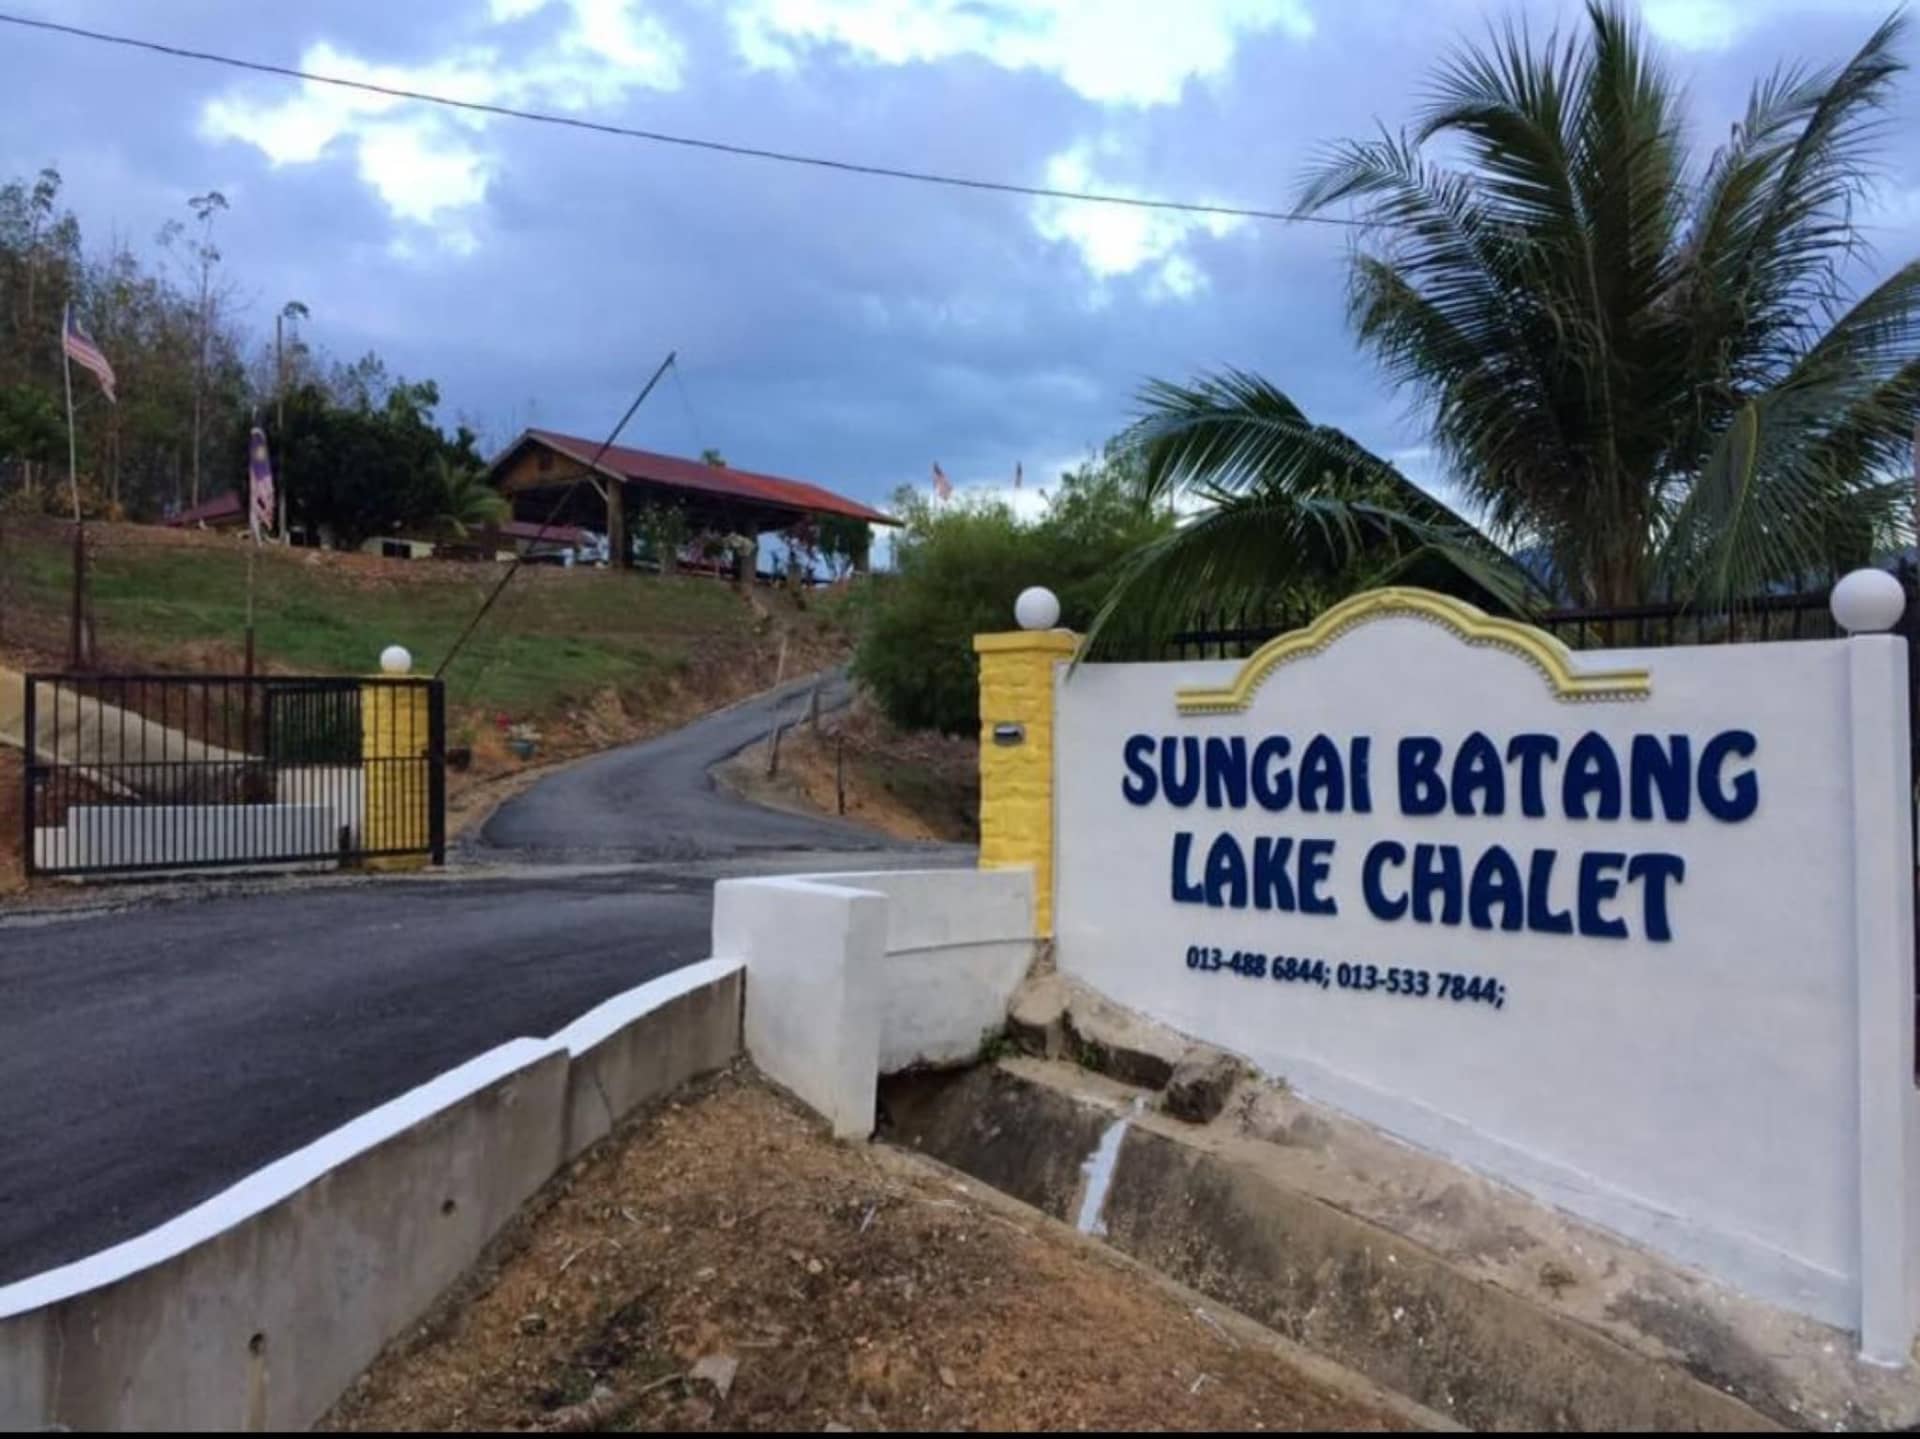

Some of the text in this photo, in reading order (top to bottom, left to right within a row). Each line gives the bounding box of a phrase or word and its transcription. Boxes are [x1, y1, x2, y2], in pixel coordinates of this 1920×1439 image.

[1121, 729, 1759, 825] SUNGAI BATANG
[1170, 831, 1687, 944] LAKE CHALET
[1186, 945, 1506, 1010] 013-488 6844; 013-533 7844;
